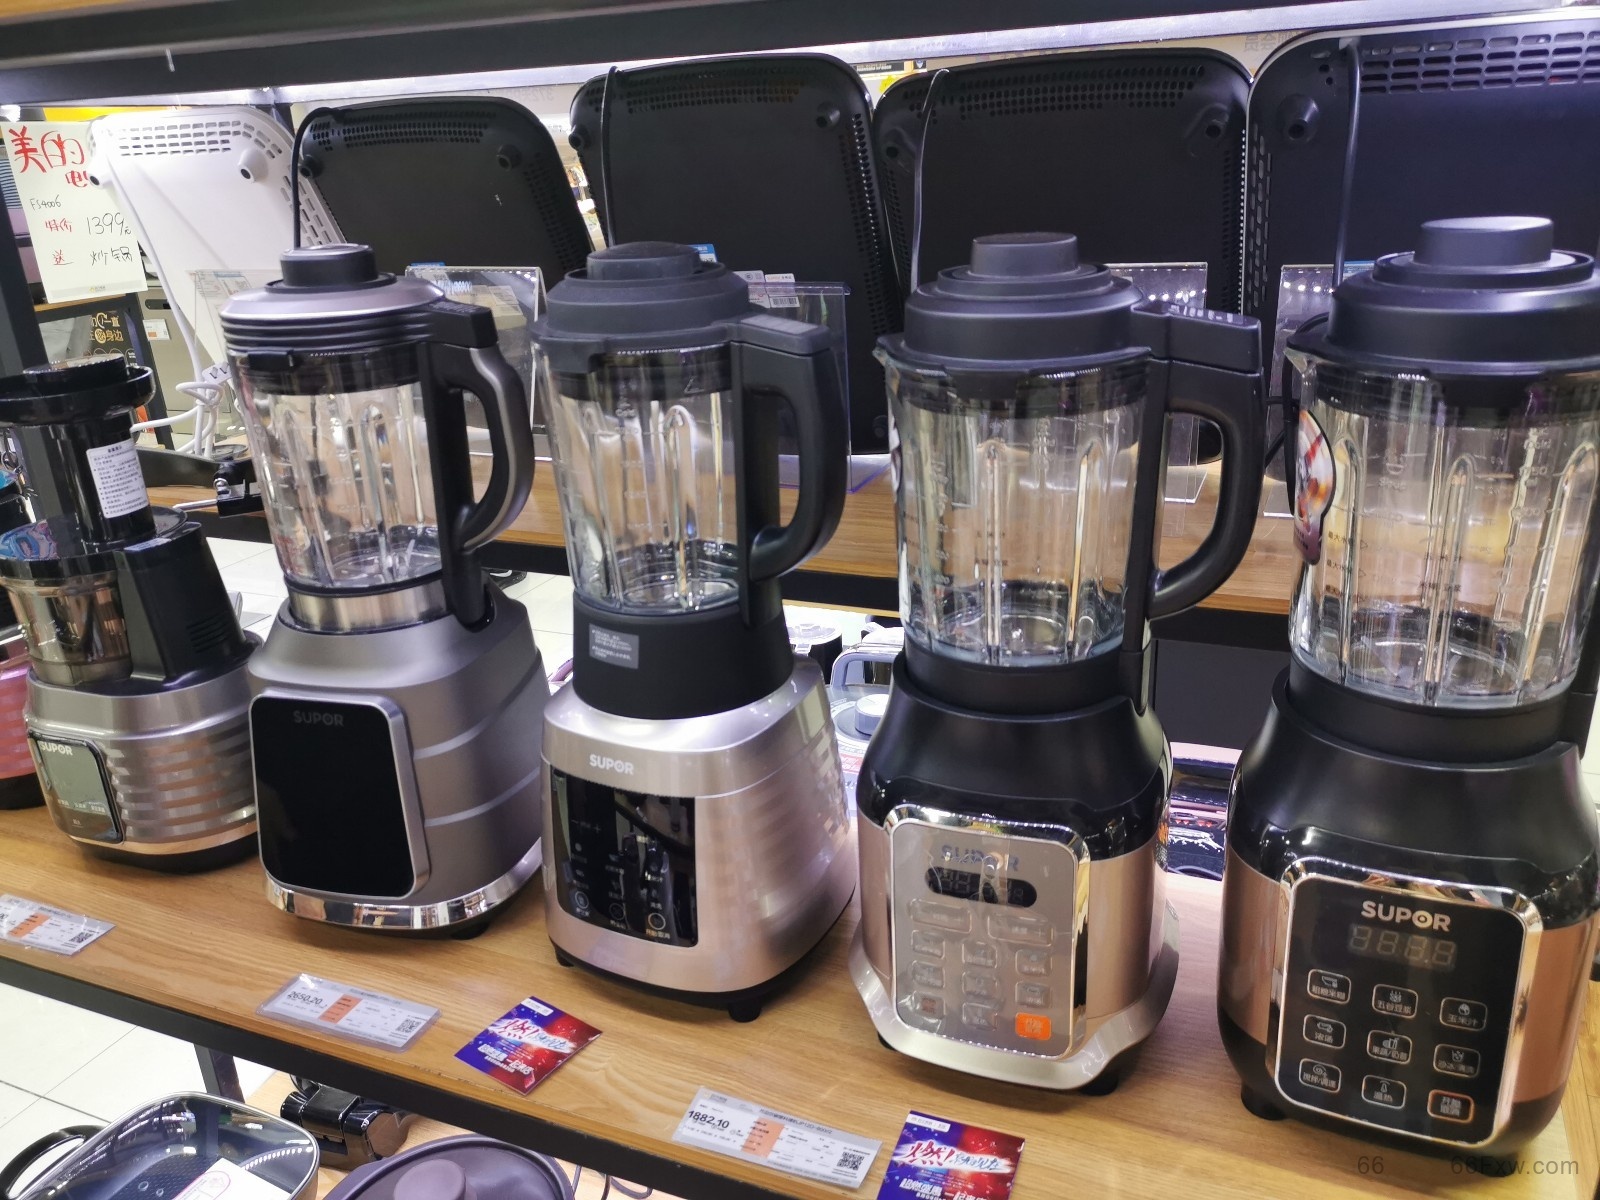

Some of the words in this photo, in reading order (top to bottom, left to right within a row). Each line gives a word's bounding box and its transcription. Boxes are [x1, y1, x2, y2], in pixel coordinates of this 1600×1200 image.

[9, 125, 85, 173] 美的
[65, 170, 89, 188] 电
[29, 194, 61, 212] FS4006
[53, 249, 75, 266] 送
[293, 709, 344, 728] SUPOR
[39, 740, 73, 756] SUPOR
[589, 753, 635, 775] SUPOR
[941, 844, 1020, 873] SUPOR
[1361, 900, 1451, 932] SUPOR
[287, 990, 324, 1006] 2650.20
[688, 1109, 730, 1130] 1882.10
